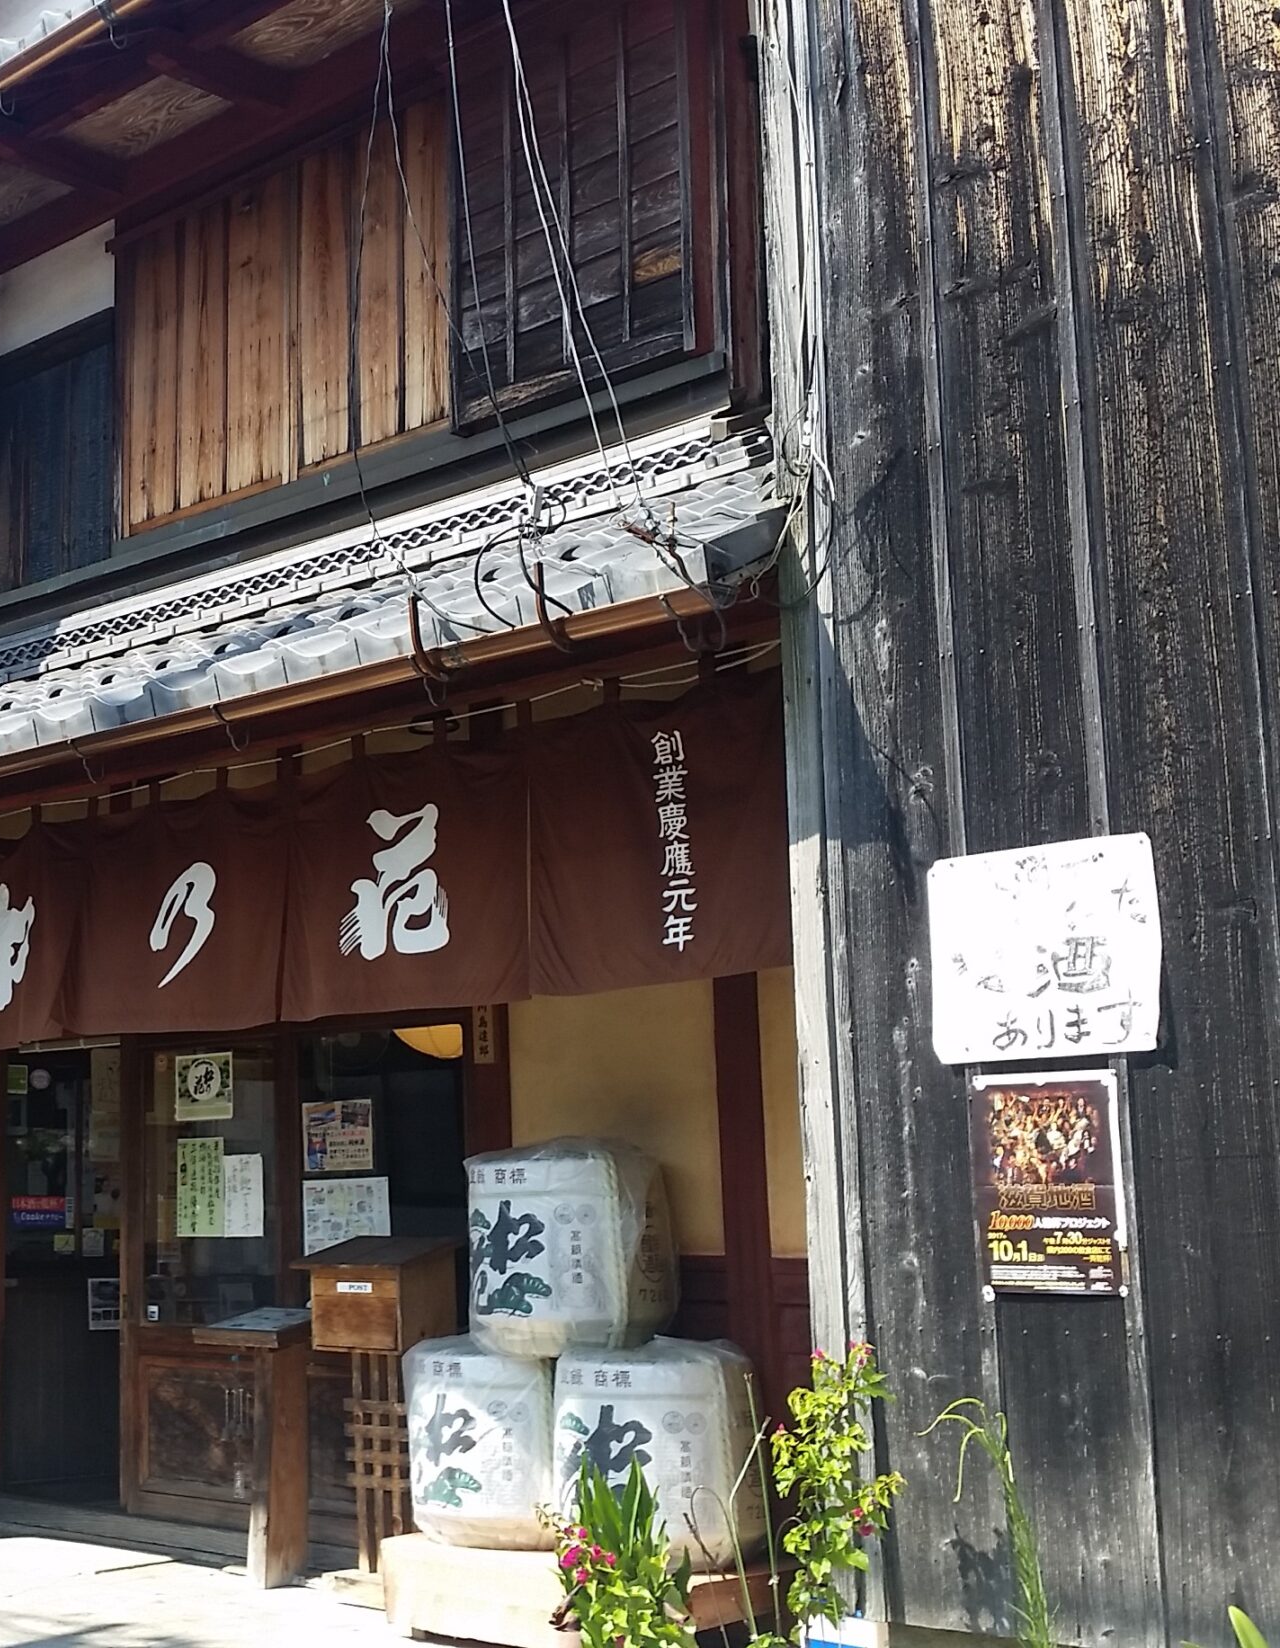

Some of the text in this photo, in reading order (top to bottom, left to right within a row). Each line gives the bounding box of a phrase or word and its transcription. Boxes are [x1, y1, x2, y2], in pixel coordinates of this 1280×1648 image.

[650, 729, 699, 952] 創業慶應元年
[992, 988, 1143, 1051] あります
